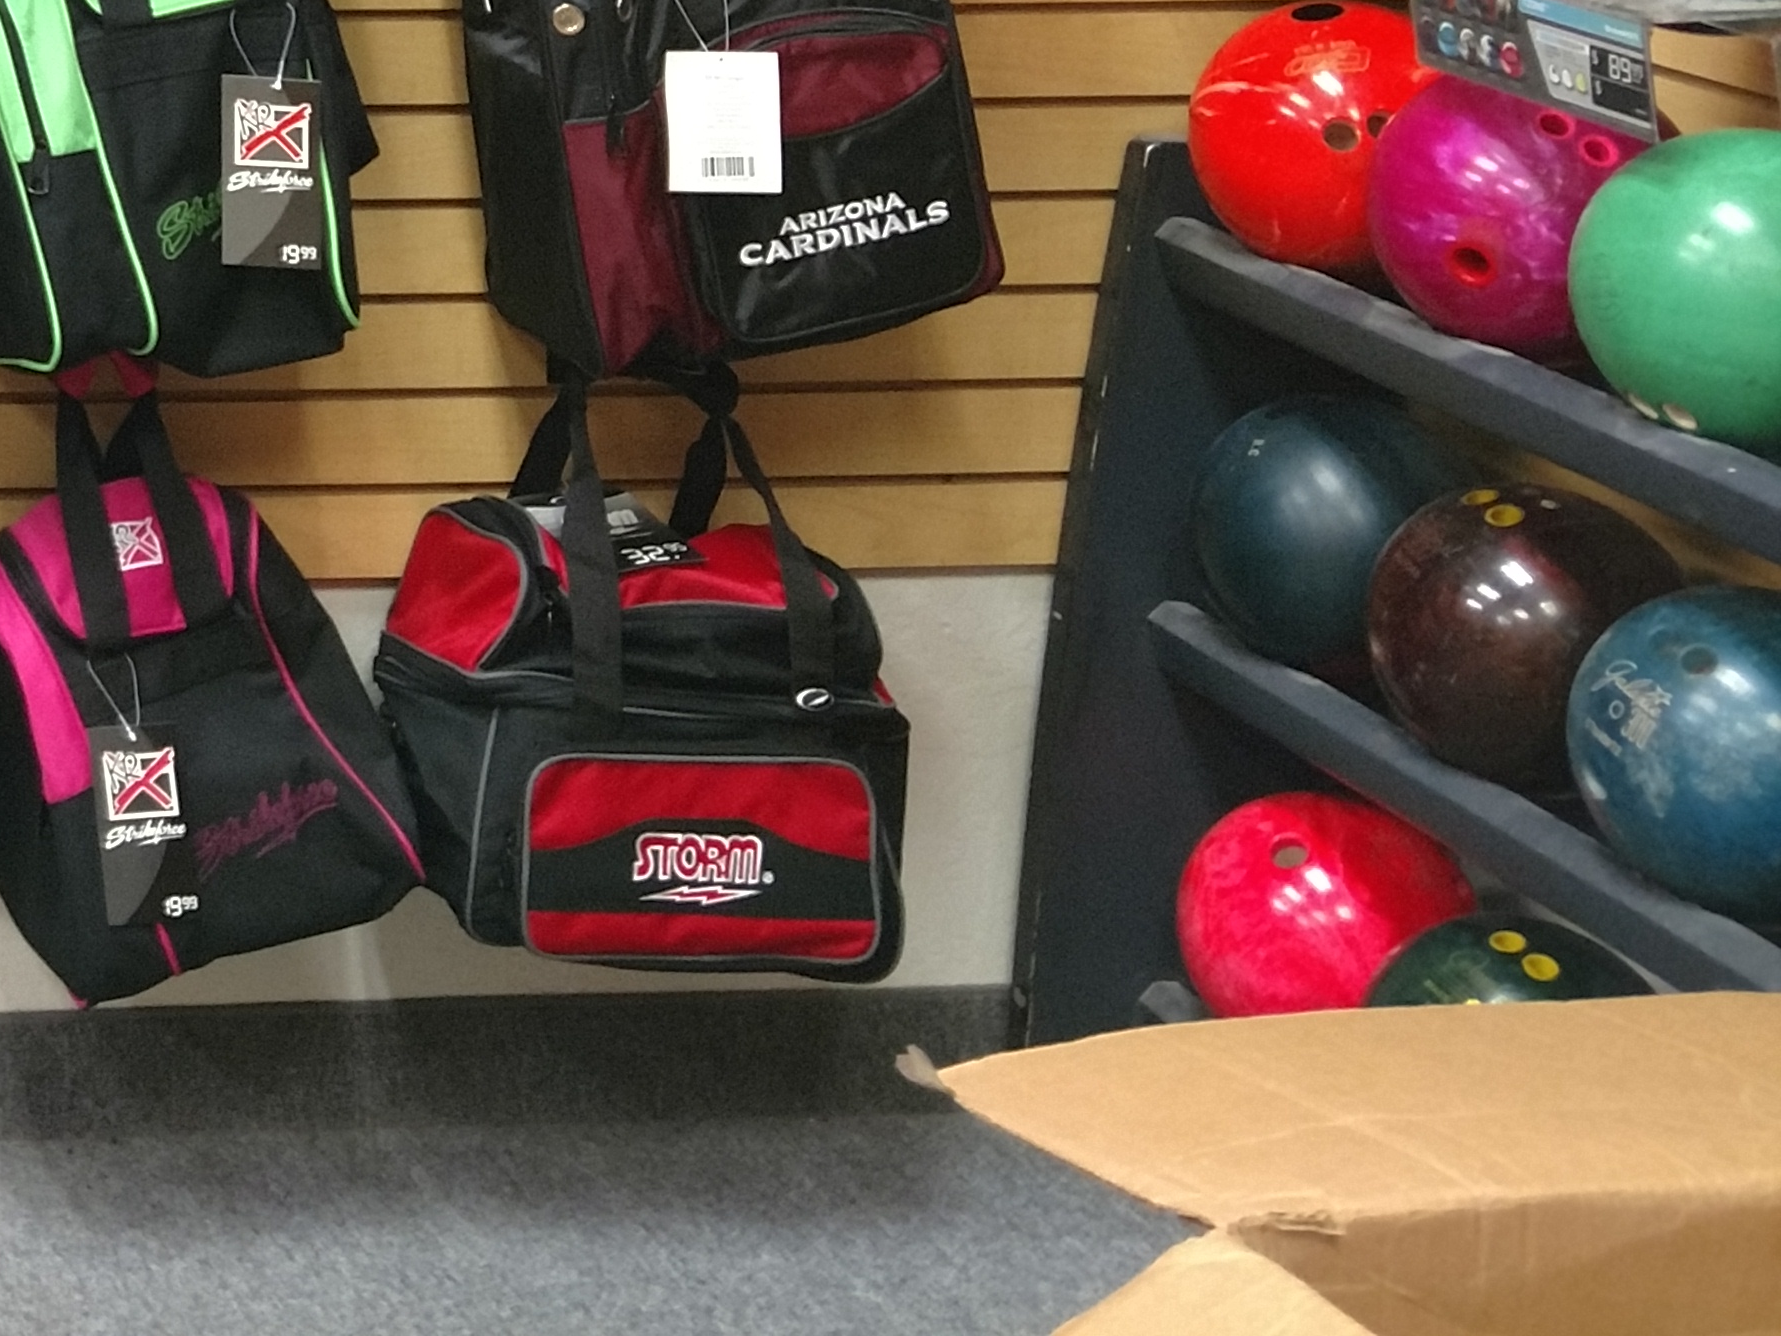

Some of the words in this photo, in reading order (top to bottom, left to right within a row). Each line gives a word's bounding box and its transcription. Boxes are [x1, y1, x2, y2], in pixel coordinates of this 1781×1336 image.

[227, 169, 314, 193] Strikeforce
[739, 201, 950, 267] CARDINALS
[780, 192, 906, 235] ARIZONA
[106, 820, 187, 849] Strikeforce
[633, 832, 764, 884] STORM
